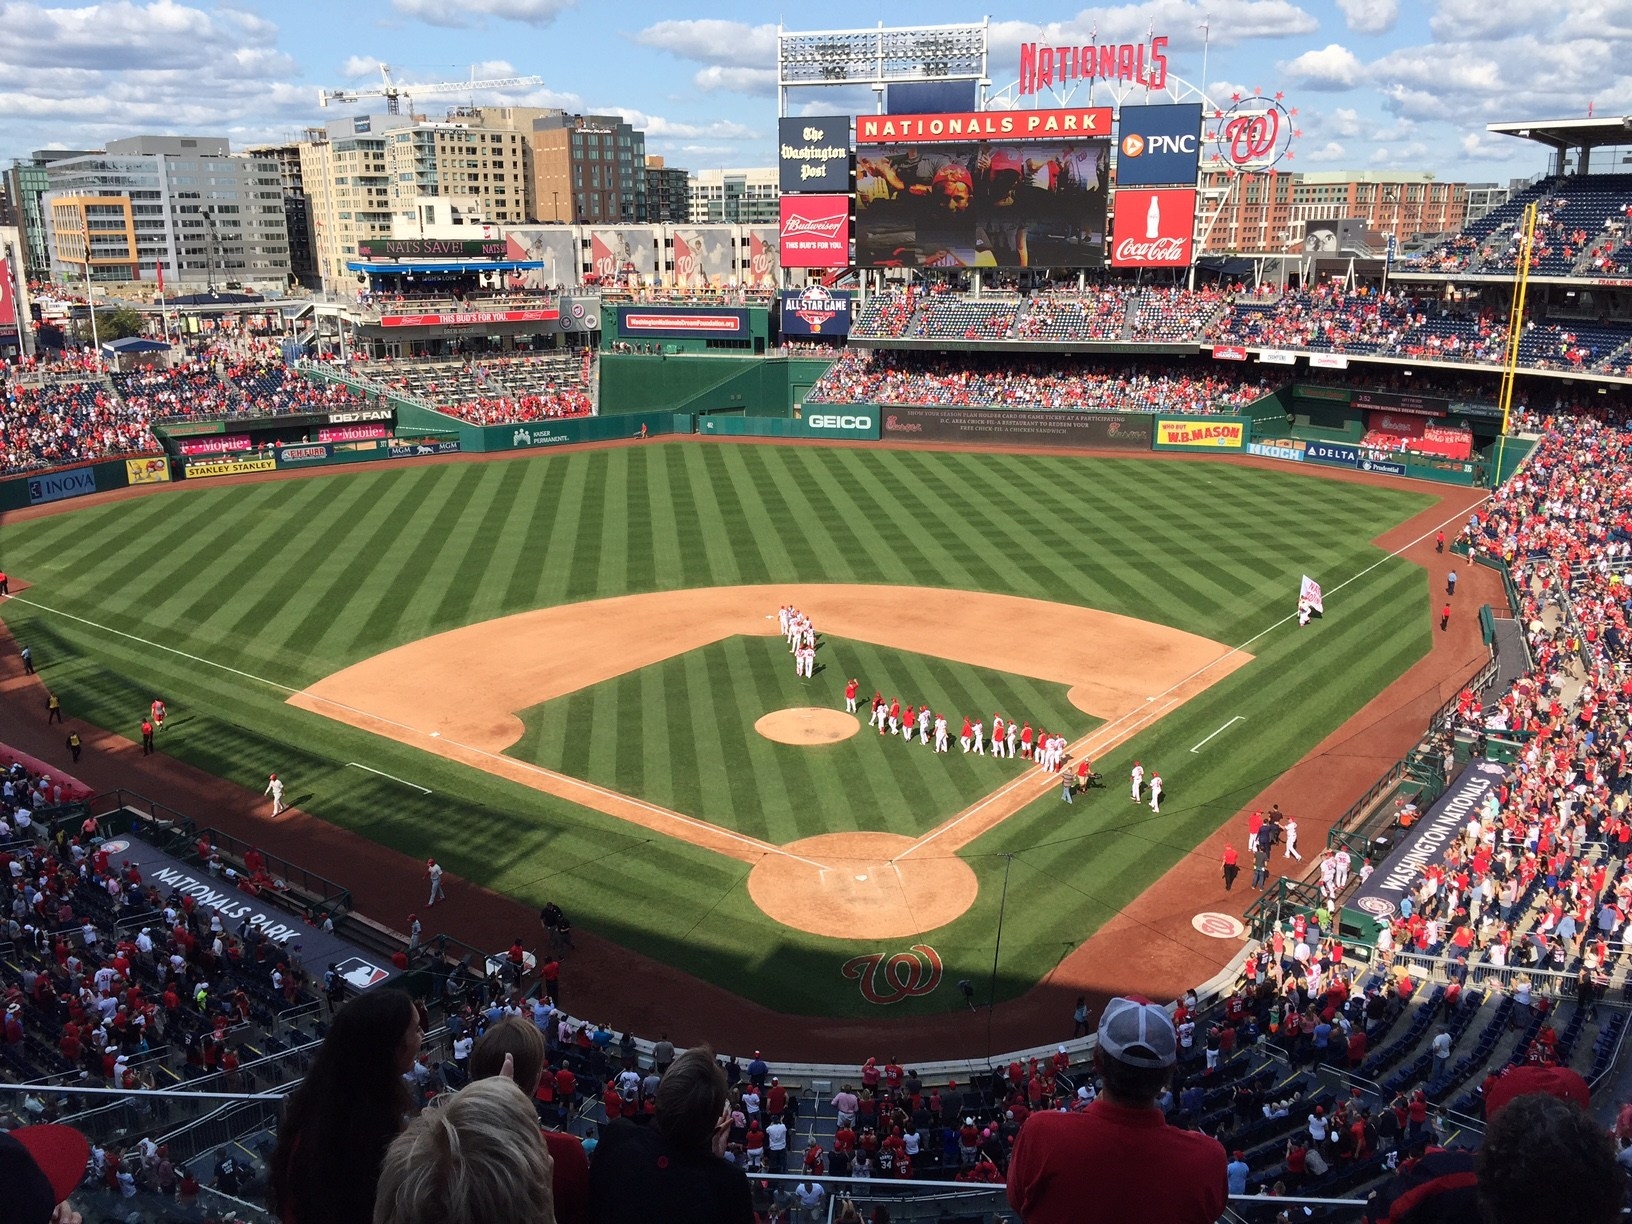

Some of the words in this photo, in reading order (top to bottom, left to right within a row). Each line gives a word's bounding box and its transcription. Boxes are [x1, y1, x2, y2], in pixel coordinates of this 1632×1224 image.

[1019, 36, 1168, 95] NATIONALS
[865, 116, 1014, 136] NATIONALS
[1027, 114, 1097, 132] PARK
[803, 126, 825, 142] The
[1225, 108, 1279, 164] W
[1147, 134, 1196, 155] PNC
[780, 143, 847, 162] Washington
[801, 164, 827, 181] Post
[786, 218, 841, 231] Budweiser
[386, 241, 421, 253] NATS
[424, 241, 464, 253] SAVE!
[1115, 236, 1188, 261] Coca-Cola
[785, 299, 800, 311] ALL
[801, 299, 824, 311] STAR
[824, 300, 846, 311] GAME
[439, 314, 454, 323] THIS
[456, 314, 477, 322] BUD'S
[478, 313, 491, 322] FOR
[630, 318, 735, 328] WashingtonNationalsDreamFoundation.org
[362, 410, 392, 420] FAN
[808, 414, 871, 429] GEICO
[439, 442, 457, 450] MGM
[533, 435, 569, 444] PERMANENTE
[392, 446, 411, 455] MGM
[1263, 444, 1299, 460] KOCH
[1319, 447, 1355, 461] DELTA
[189, 465, 230, 476] STANLEY
[232, 461, 273, 472] STANLEY
[1372, 463, 1400, 474] Prudential
[46, 473, 94, 495] INOVA
[1380, 823, 1454, 891] WASHINGTON
[1436, 777, 1491, 826] NATIONALS
[151, 866, 252, 919] NATIONALS
[250, 913, 302, 943] PARK
[1553, 955, 1565, 963] 34
[101, 974, 109, 982] 31
[841, 943, 943, 1004] W
[880, 1160, 892, 1169] 34
